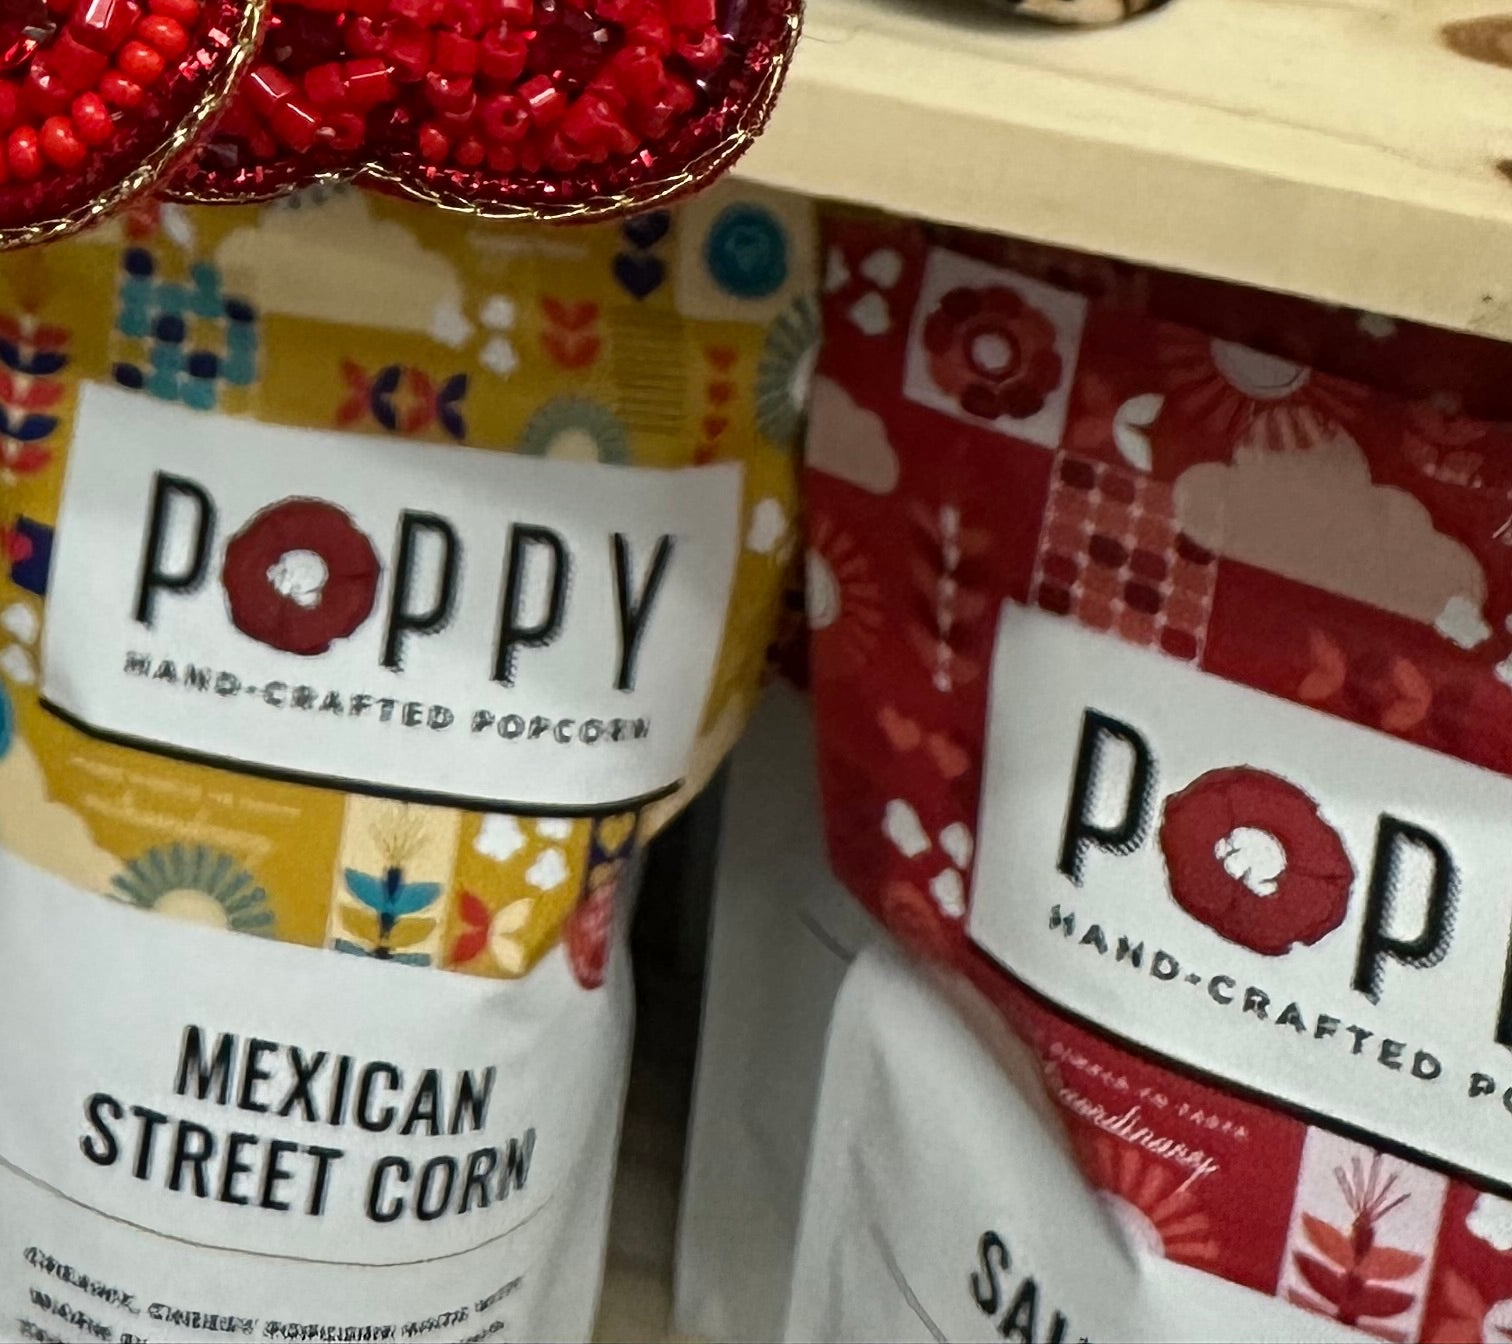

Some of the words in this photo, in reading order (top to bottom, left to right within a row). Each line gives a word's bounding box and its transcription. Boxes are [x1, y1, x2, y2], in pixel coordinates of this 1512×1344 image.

[134, 469, 678, 693] POPPY
[123, 649, 455, 731] HAND-CRAFTED
[470, 708, 651, 745] POPCORN
[1056, 707, 1512, 1050] POP
[1048, 904, 1443, 1082] HAND-CRAFTED
[80, 1092, 344, 1217] STREET
[365, 1127, 537, 1224] CORN
[173, 1024, 497, 1137] MEXICAN
